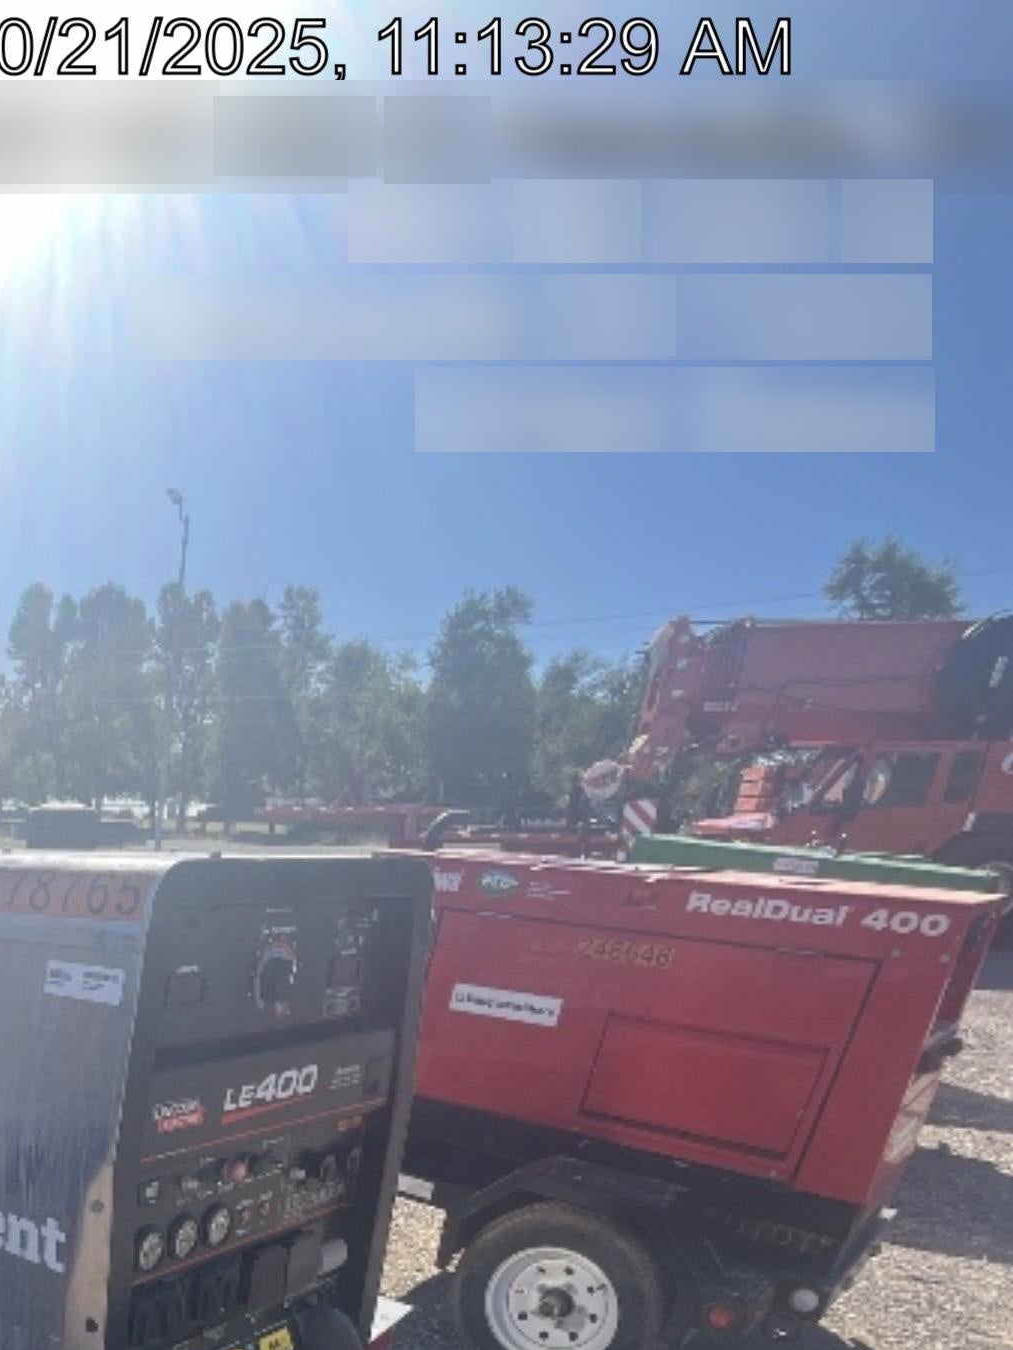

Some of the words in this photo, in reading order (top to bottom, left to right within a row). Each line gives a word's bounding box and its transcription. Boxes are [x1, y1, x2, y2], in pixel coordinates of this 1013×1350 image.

[686, 891, 850, 926] RealDual
[860, 908, 951, 937] 400
[223, 1064, 319, 1112] LE400
